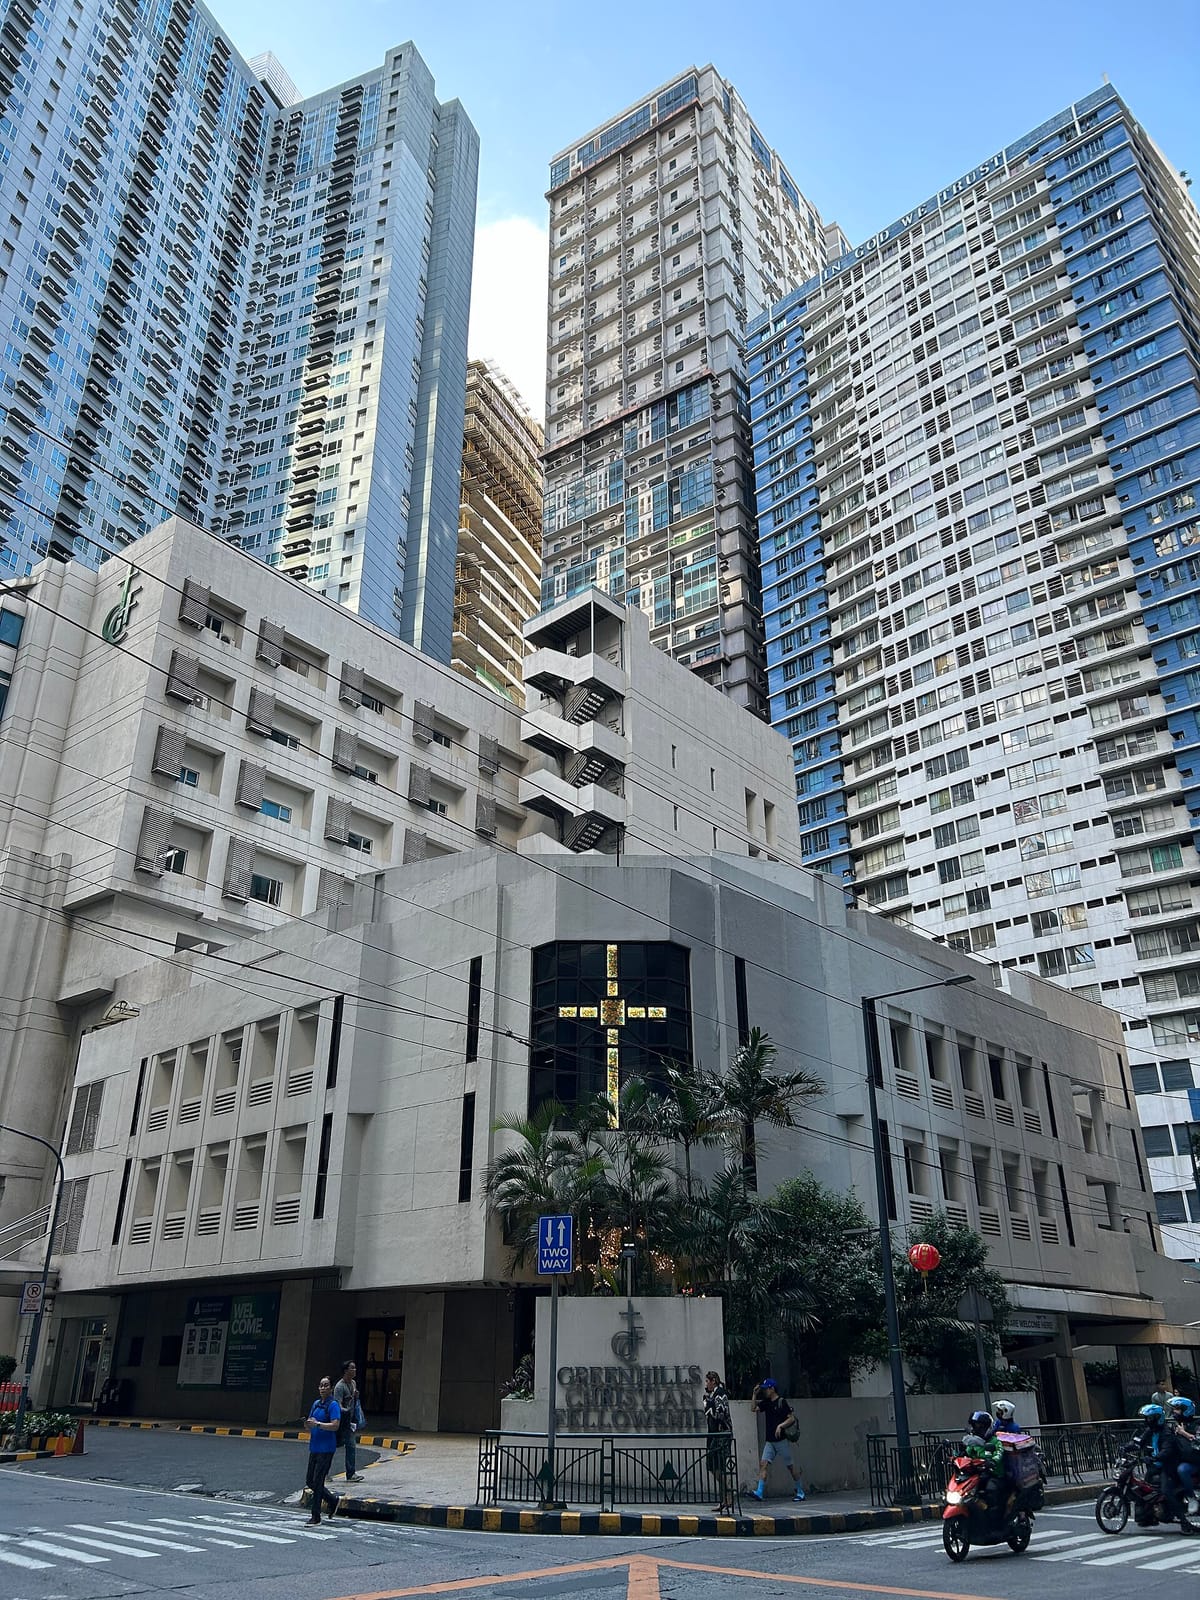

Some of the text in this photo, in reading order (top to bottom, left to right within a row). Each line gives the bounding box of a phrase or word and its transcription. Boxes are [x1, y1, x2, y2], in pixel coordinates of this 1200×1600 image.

[823, 154, 1005, 282] IN GOD WE TRUST
[541, 1247, 569, 1258] TWO
[541, 1258, 569, 1269] WAY
[232, 1302, 255, 1319] WEL
[231, 1317, 264, 1336] COME
[557, 1365, 702, 1386] GREENHILLS
[565, 1386, 697, 1408] CHRISTIAN
[554, 1408, 707, 1429] FELLOWSHIP
